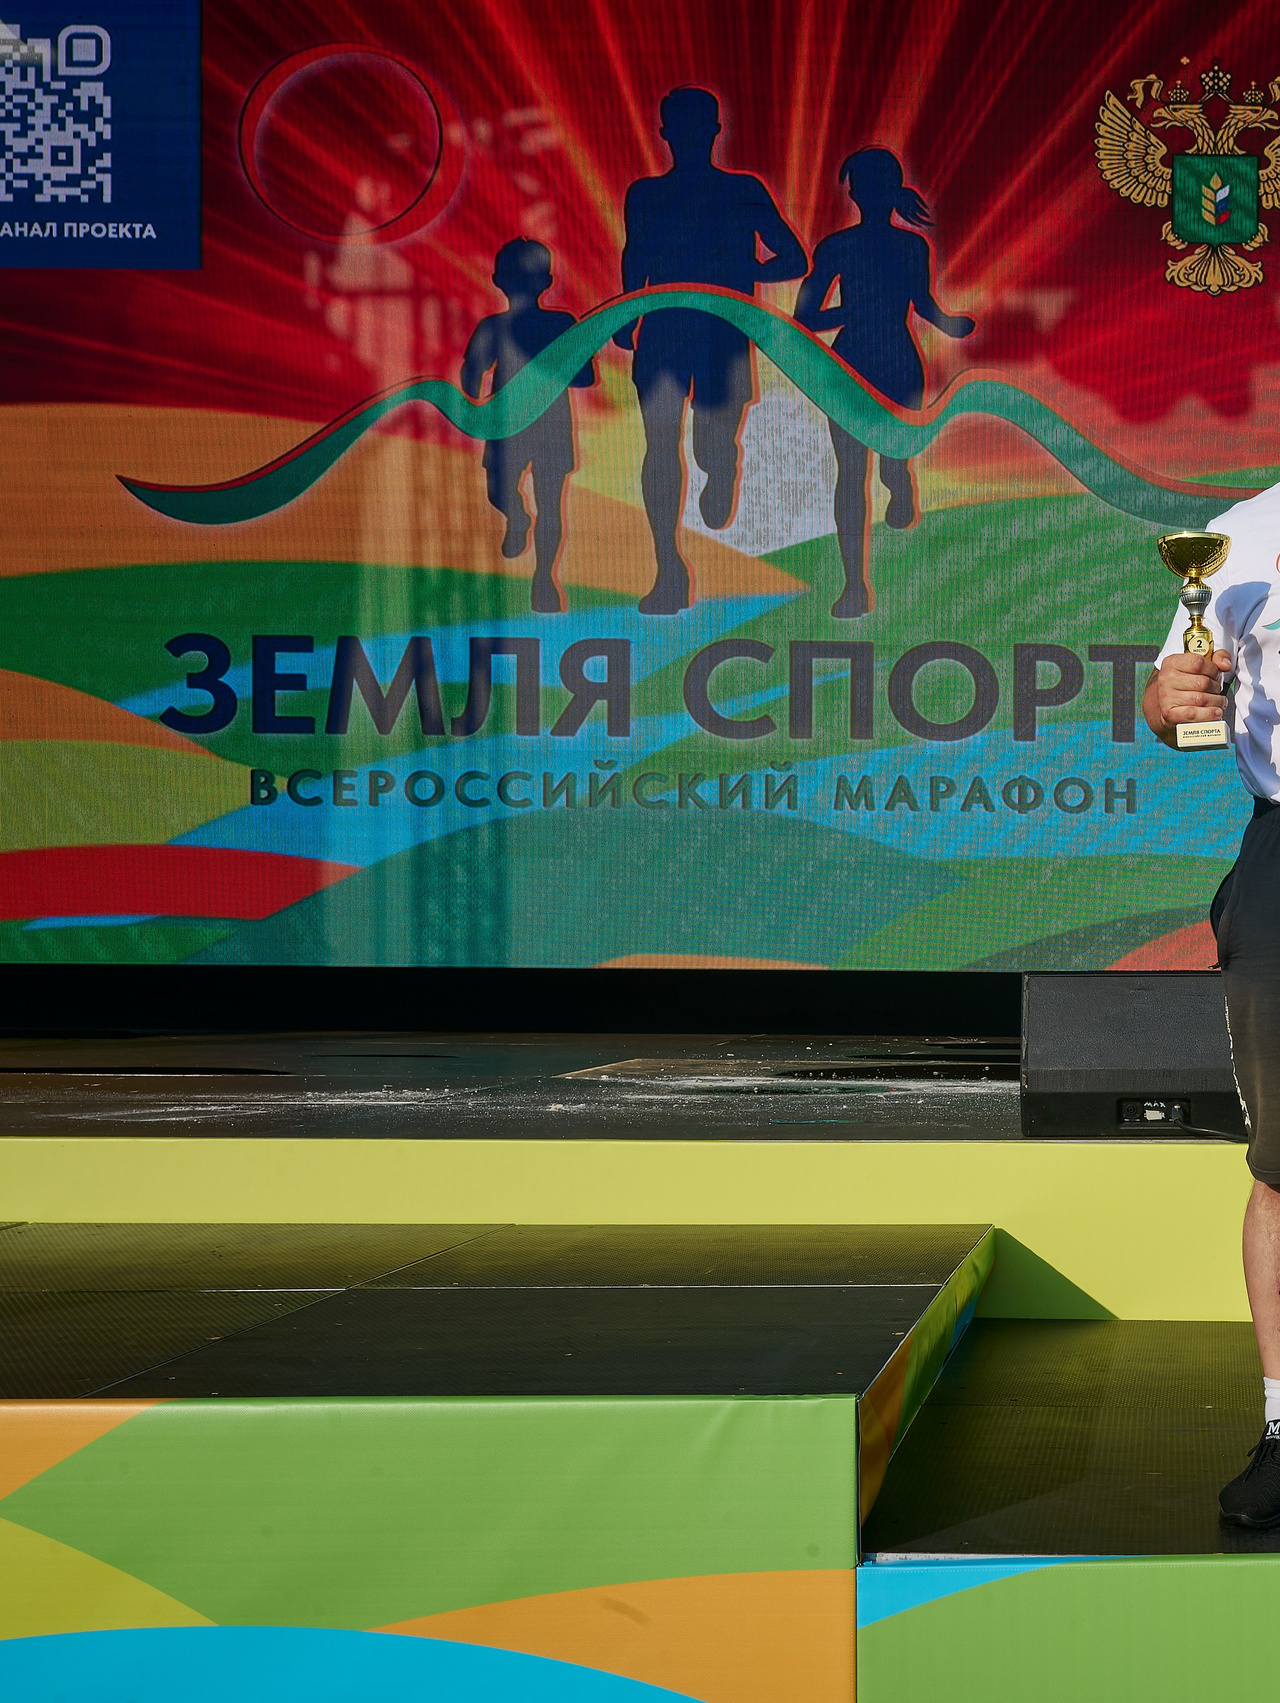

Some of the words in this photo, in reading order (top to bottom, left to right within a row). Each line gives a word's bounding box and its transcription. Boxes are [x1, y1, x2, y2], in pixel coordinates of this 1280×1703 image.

[0, 222, 57, 238] АНАЛ
[63, 222, 157, 239] ПРОЕКТА
[1196, 639, 1203, 649] 2
[158, 632, 632, 738] ЗЕМЛЯ
[683, 638, 1163, 743] СПОРТ
[249, 759, 799, 811] ВСЕРОССИЙСКИЙ
[833, 774, 1137, 815] МАРАФОН
